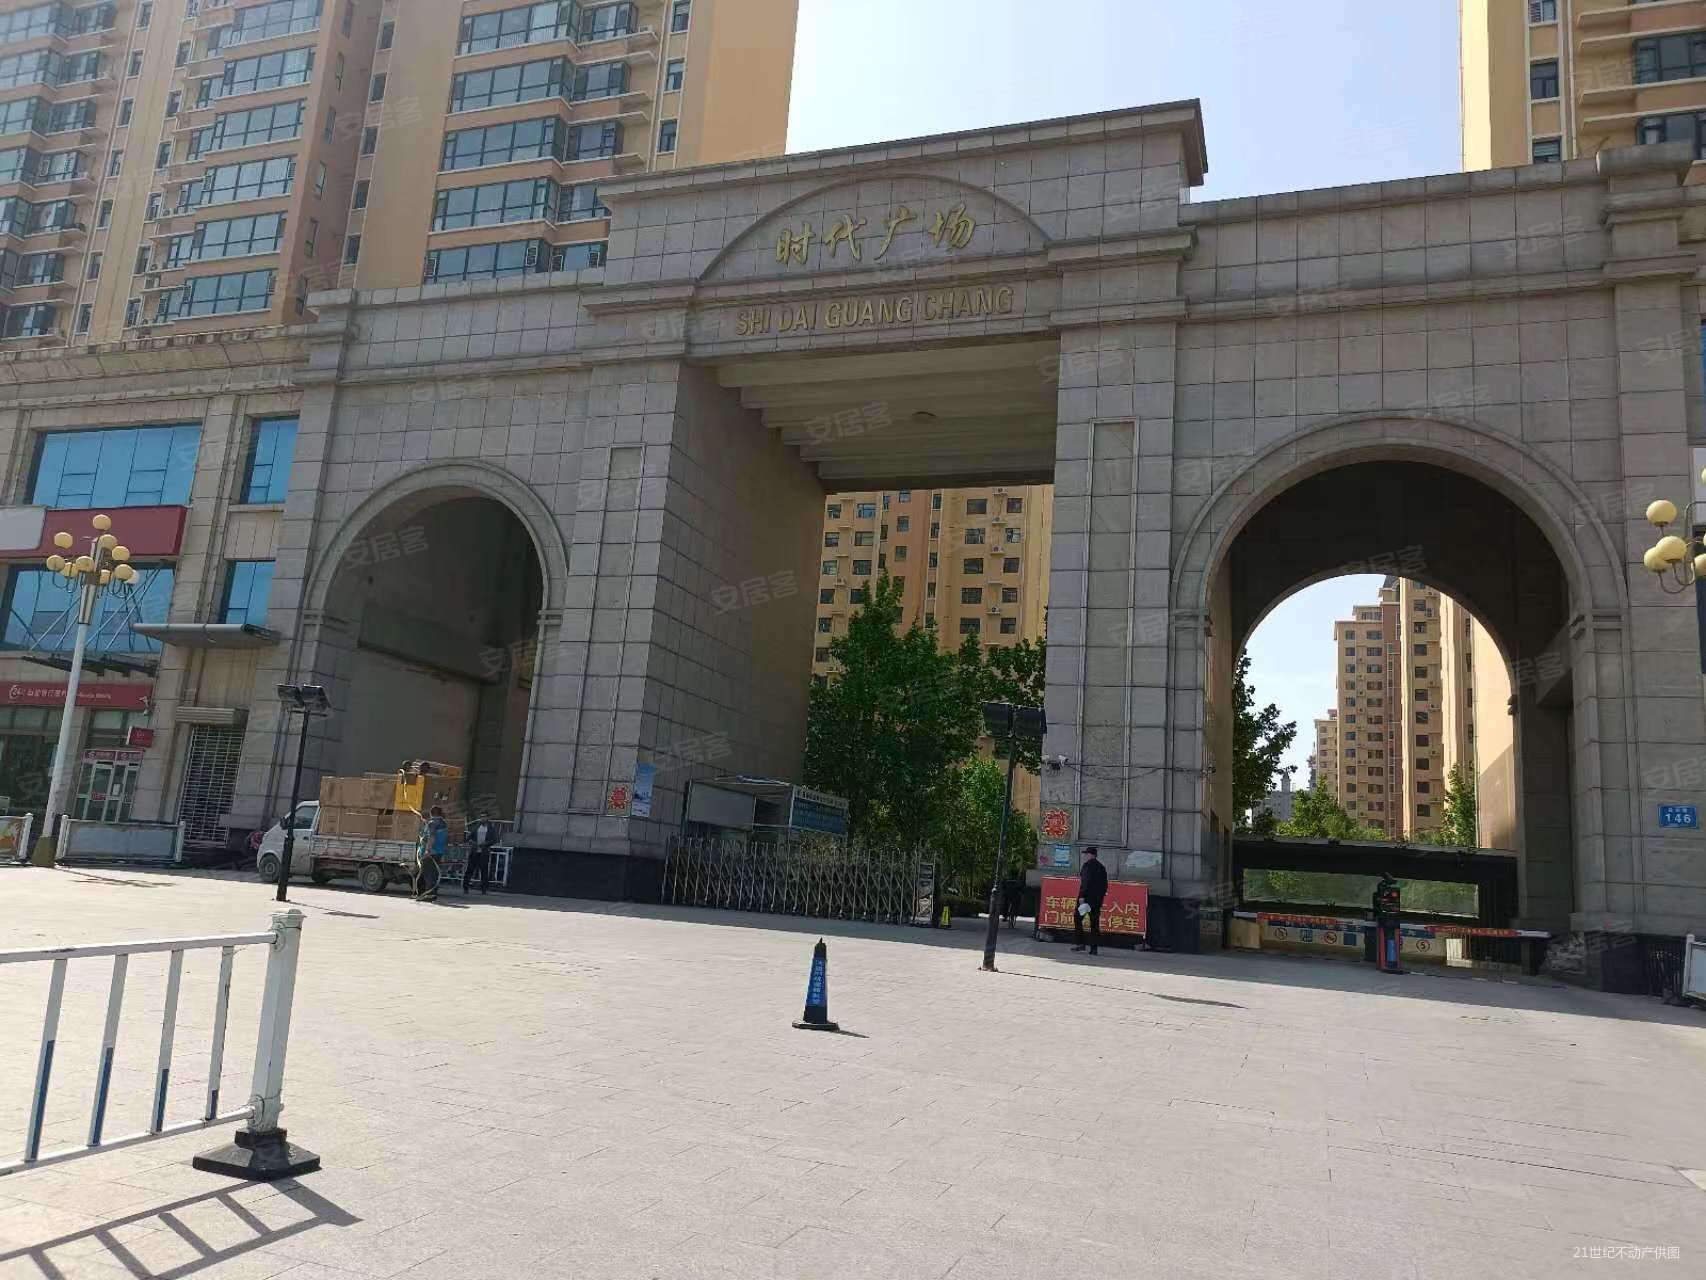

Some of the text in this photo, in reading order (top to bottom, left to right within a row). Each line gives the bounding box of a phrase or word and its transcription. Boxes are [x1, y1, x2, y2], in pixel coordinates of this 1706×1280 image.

[775, 203, 976, 266] 时代广场
[735, 286, 1014, 336] SHI DAI GUANG CHANG
[1665, 813, 1691, 824] 146
[1045, 896, 1139, 915] 车辆入内
